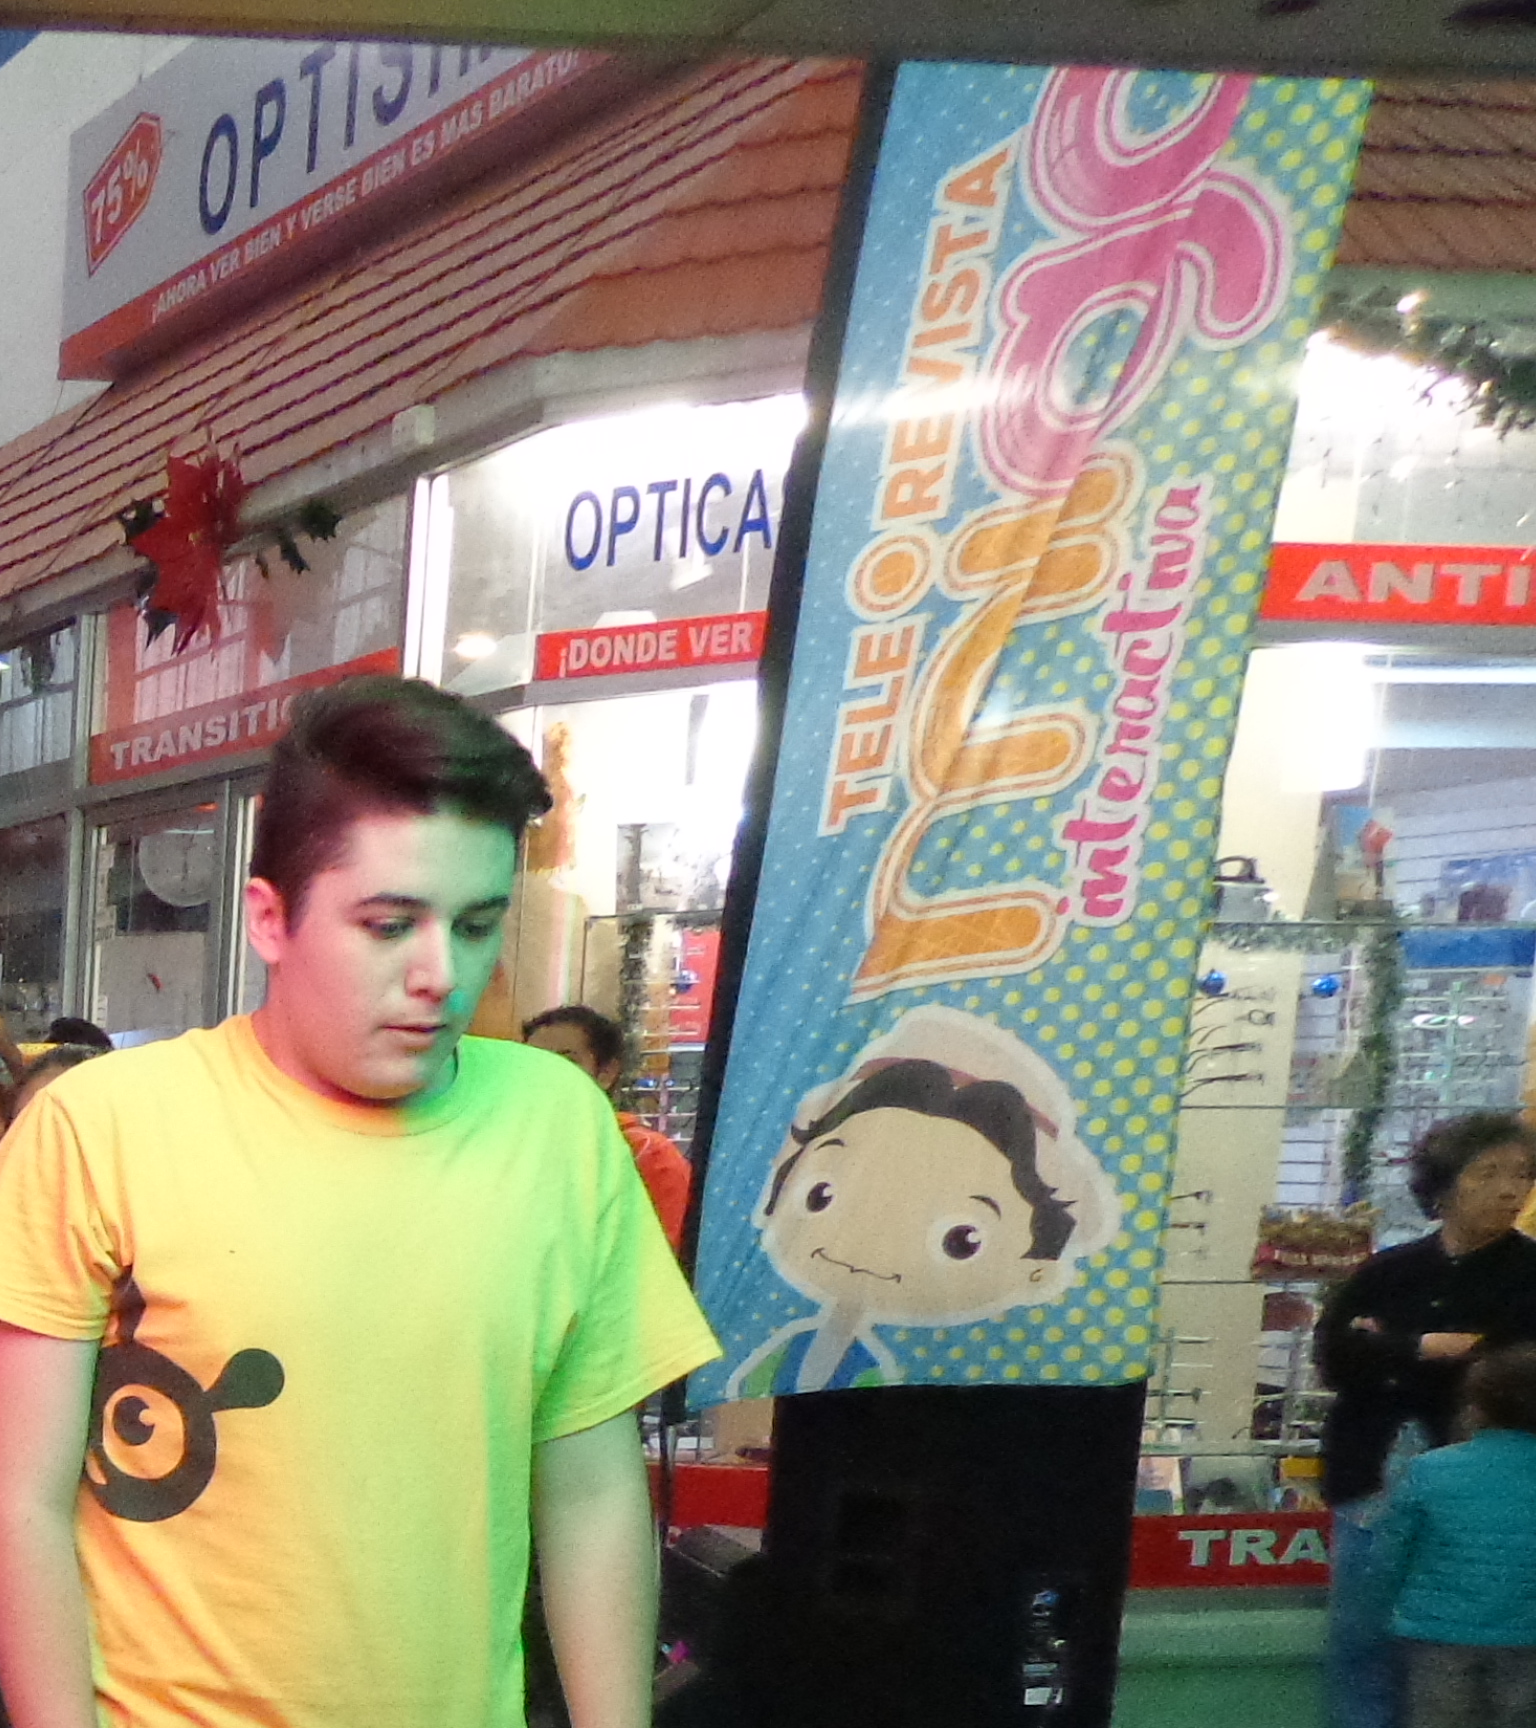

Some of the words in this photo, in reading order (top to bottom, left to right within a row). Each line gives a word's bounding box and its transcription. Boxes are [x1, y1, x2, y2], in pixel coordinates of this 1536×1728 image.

[91, 138, 149, 245] 75%
[210, 248, 240, 284] VER
[245, 223, 282, 264] BIEN
[286, 212, 299, 240] Y
[301, 177, 357, 231] VERSE
[361, 148, 406, 197] BIEN
[412, 129, 436, 166] ES
[565, 468, 772, 572] OPTICA
[827, 627, 913, 830] TELE
[883, 148, 1013, 519] REVISTA
[1295, 559, 1532, 607] ANTI
[688, 621, 753, 658] VER
[110, 695, 293, 771] TRANSITI
[1054, 483, 1203, 918] interactiva
[1178, 1528, 1329, 1567] TRA
